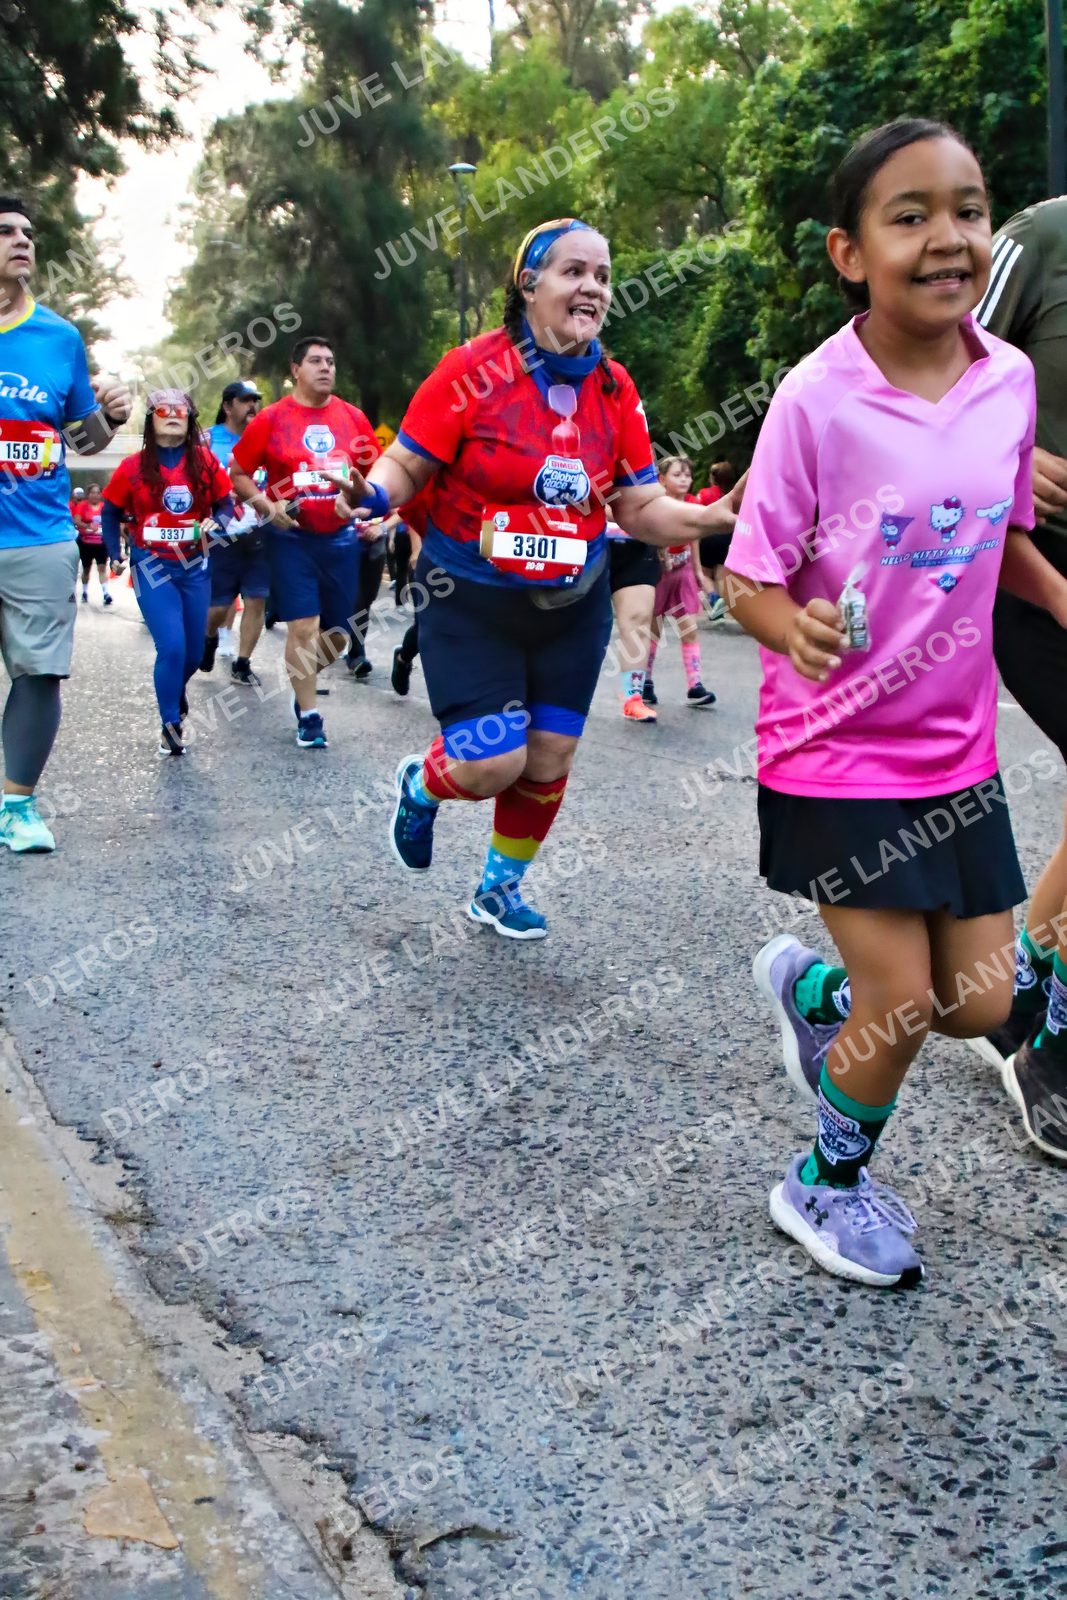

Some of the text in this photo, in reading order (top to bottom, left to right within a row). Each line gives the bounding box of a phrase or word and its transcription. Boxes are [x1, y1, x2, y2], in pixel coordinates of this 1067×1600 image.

[6, 442, 39, 460] 1583
[551, 461, 579, 470] BIMBO
[543, 478, 568, 490] Race
[550, 471, 580, 484] Global
[160, 528, 185, 539] 3337
[513, 535, 557, 560] 3301
[880, 552, 910, 565] HELLO
[912, 548, 944, 559] KITTY
[946, 546, 970, 556] AND
